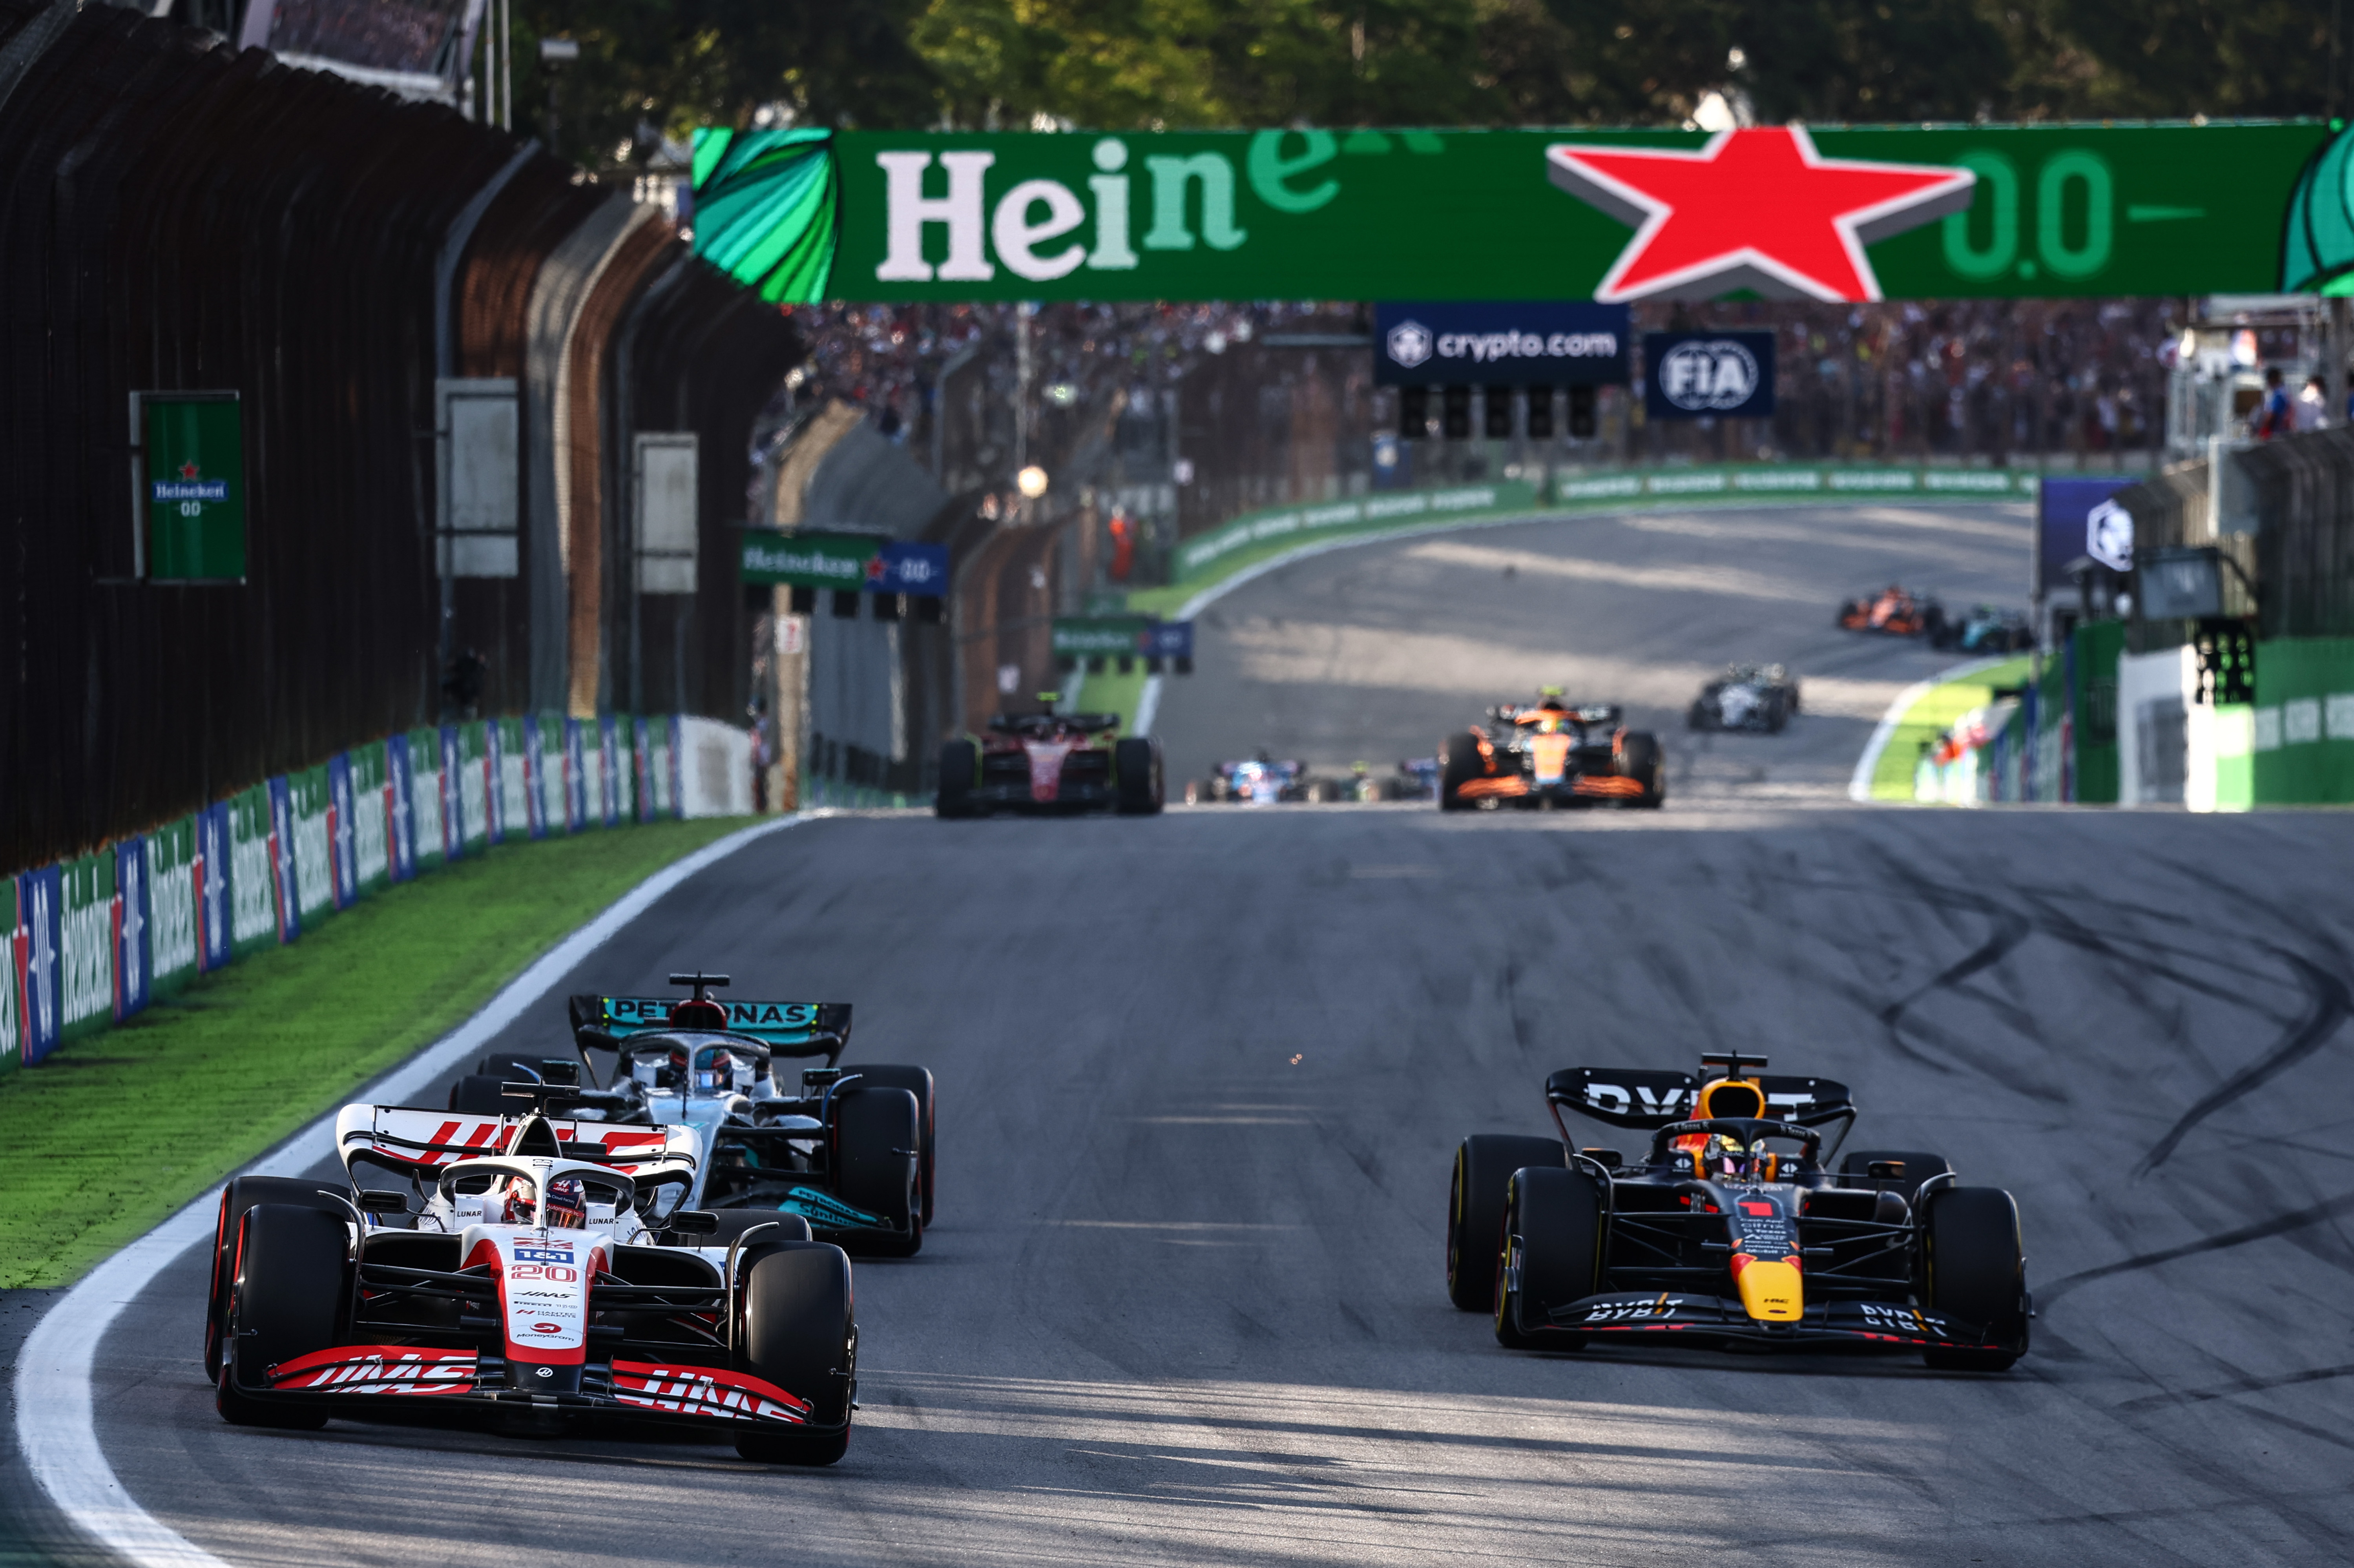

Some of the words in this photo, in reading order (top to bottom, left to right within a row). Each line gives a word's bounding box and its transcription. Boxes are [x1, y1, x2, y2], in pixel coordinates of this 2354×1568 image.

[874, 129, 1447, 282] Heine
[1436, 329, 1618, 363] crypto.com
[1668, 356, 1749, 395] FIA
[156, 483, 224, 498] Heineken
[615, 1000, 807, 1024] PETNAS
[1586, 1078, 1813, 1122] BYT
[546, 1204, 573, 1214] Automation
[1737, 1202, 1773, 1216] 1
[519, 1251, 567, 1261] 1&1
[511, 1265, 577, 1283] 20
[516, 1333, 575, 1342] MoneyGram
